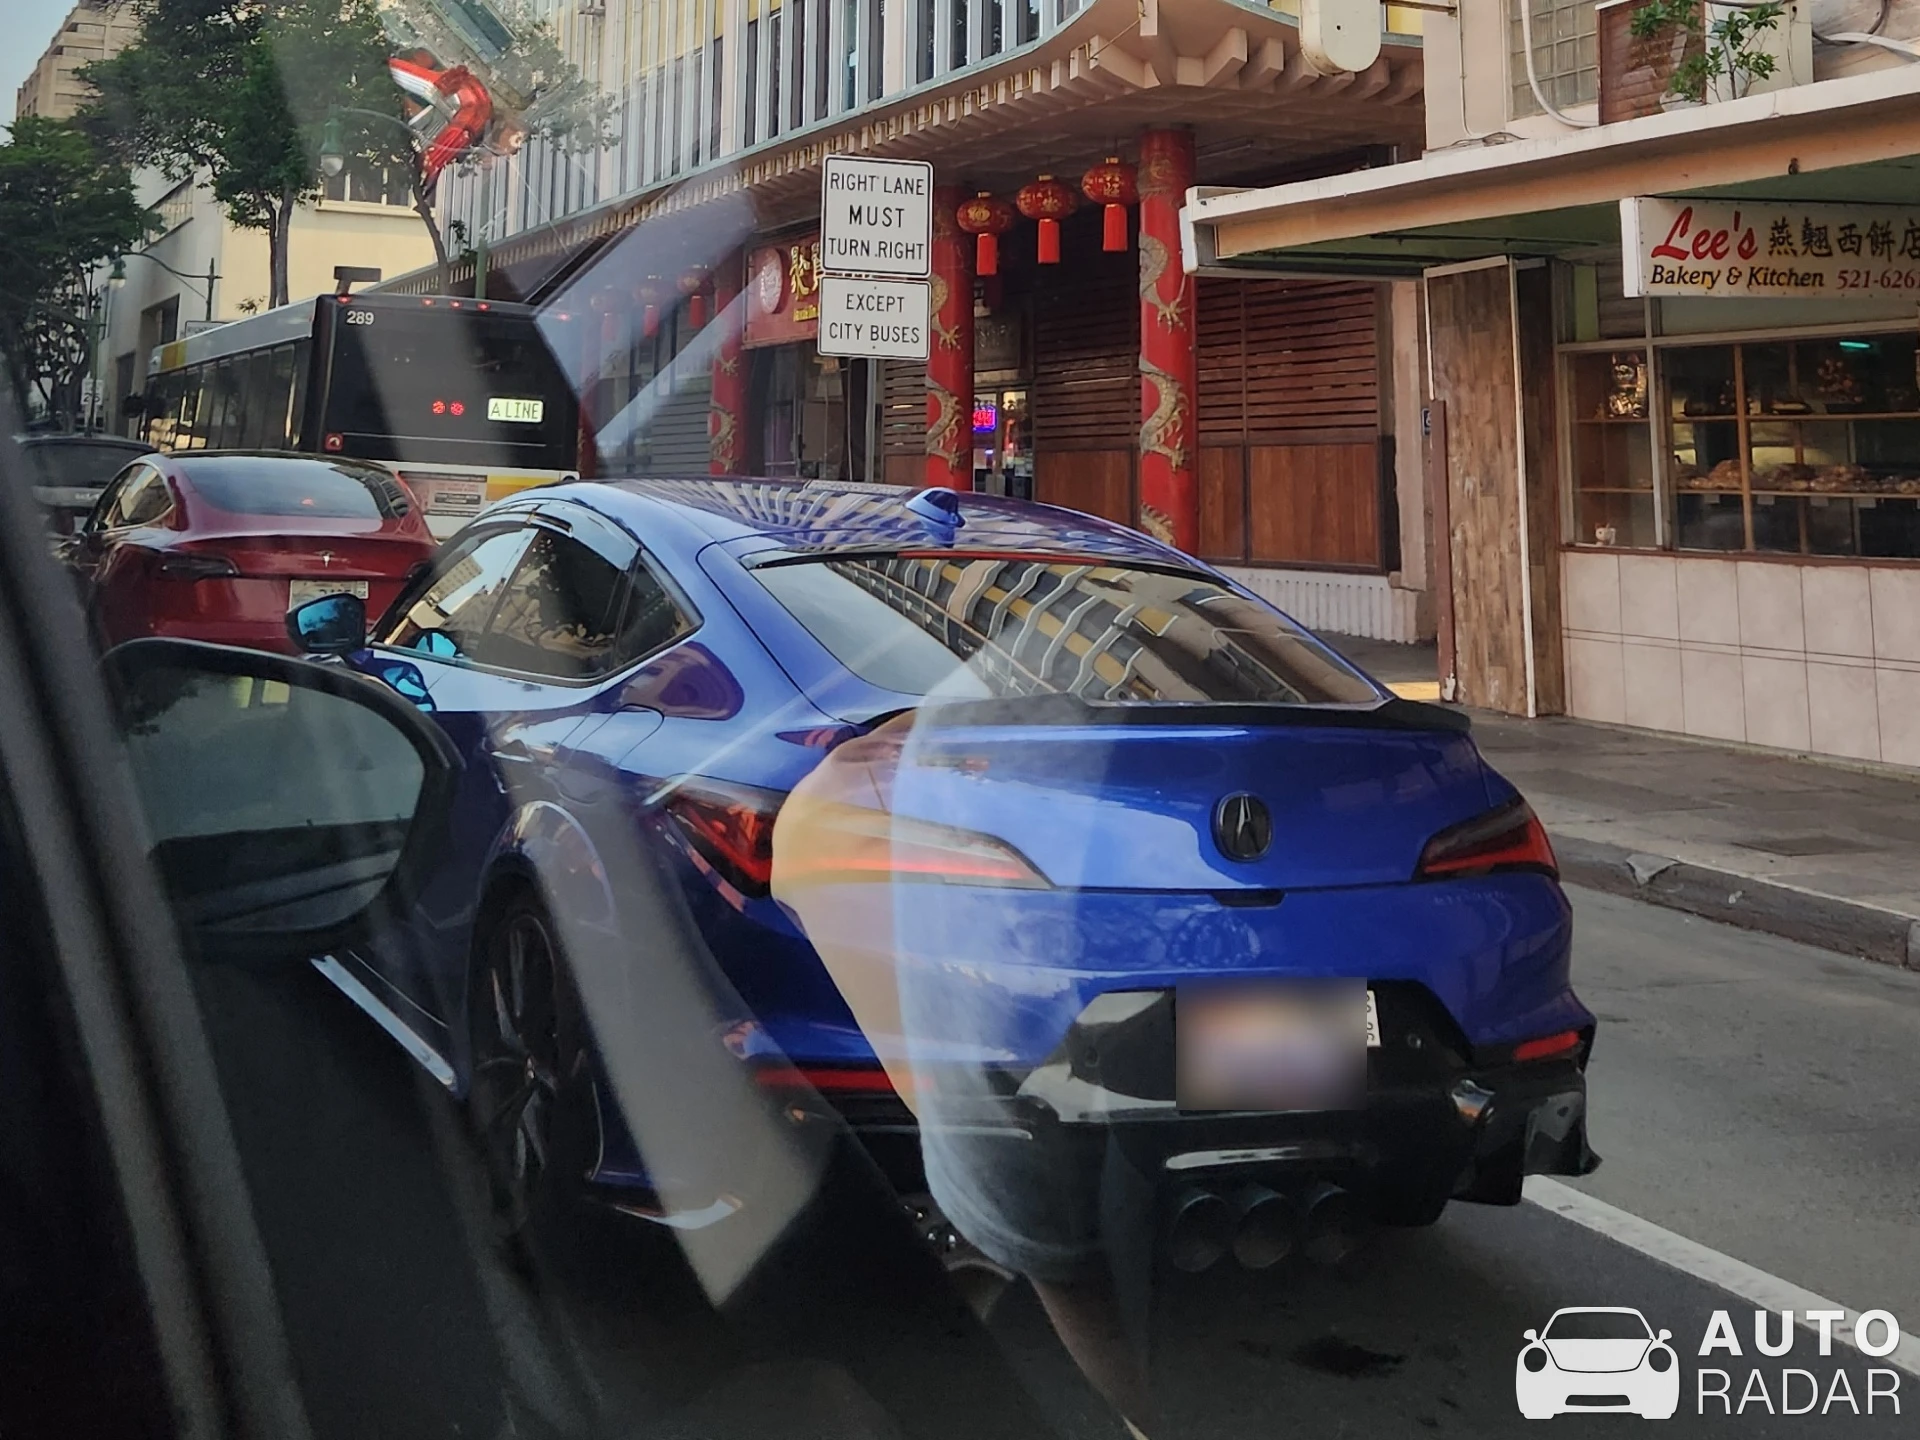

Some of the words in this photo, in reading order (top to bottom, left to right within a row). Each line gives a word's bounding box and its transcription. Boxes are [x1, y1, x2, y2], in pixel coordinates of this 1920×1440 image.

[830, 172, 876, 192] RIGHT
[883, 176, 925, 196] LANE
[849, 205, 905, 228] MUST
[1651, 206, 1758, 260] Lee's
[828, 237, 870, 257] TURN
[878, 241, 925, 260] RIGHT
[1650, 264, 1721, 290] Bakery
[1726, 266, 1743, 286] &
[1746, 266, 1825, 292] Kitchen
[1836, 267, 1920, 290] 521-626
[846, 293, 905, 313] EXCEPT
[347, 311, 374, 325] 289
[829, 322, 863, 341] CITY
[870, 325, 920, 344] BUSES
[491, 402, 501, 417] A
[505, 401, 540, 420] LINE
